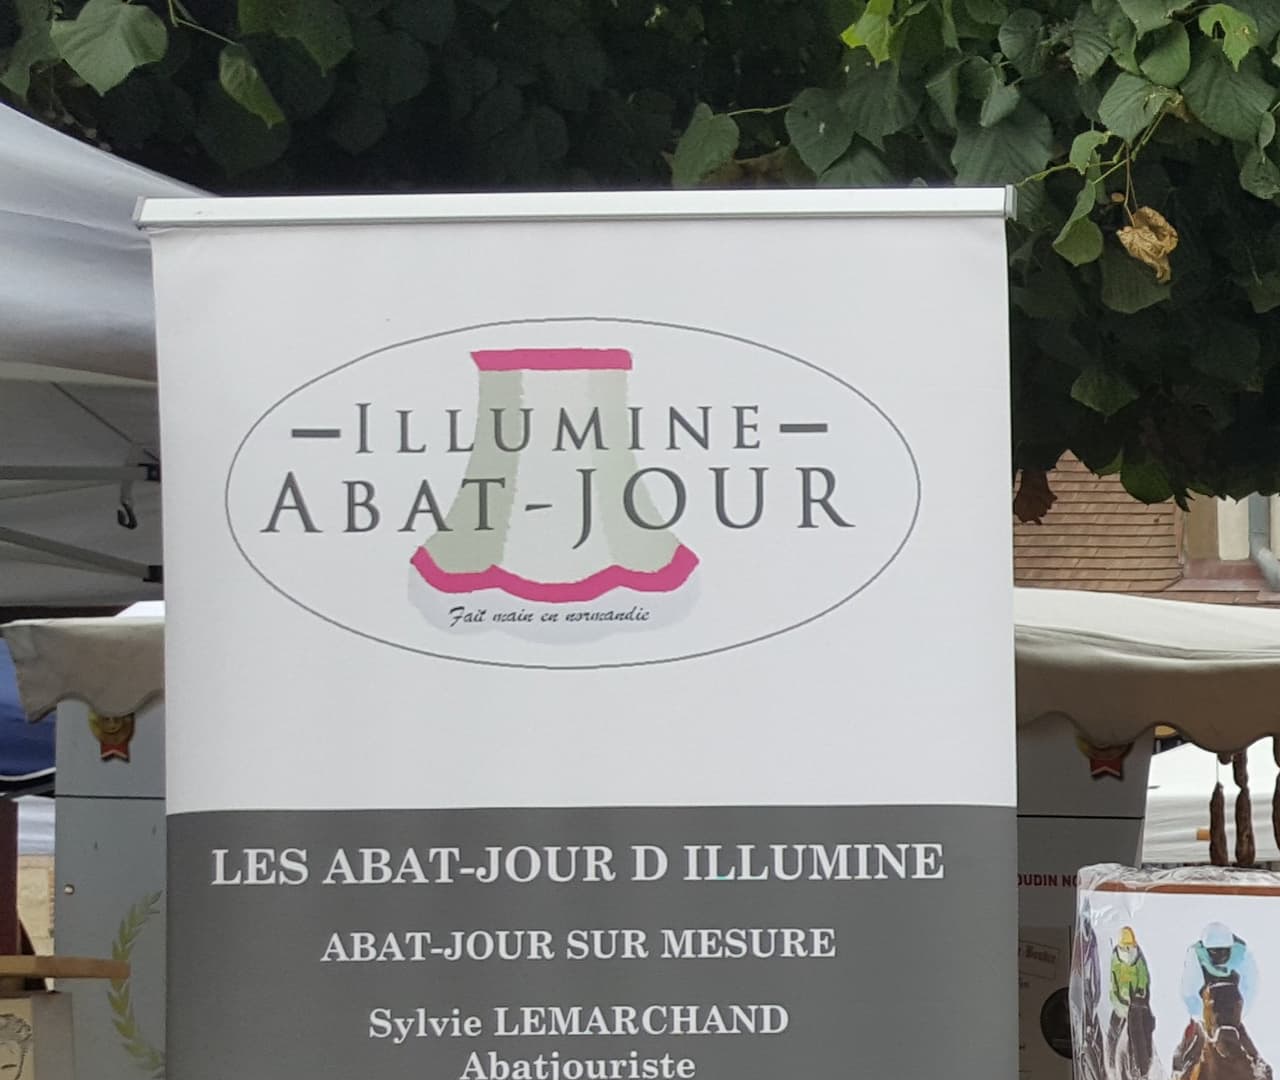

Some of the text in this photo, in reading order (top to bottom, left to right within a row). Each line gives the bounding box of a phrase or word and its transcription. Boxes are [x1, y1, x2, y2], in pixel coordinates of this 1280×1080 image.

[260, 465, 857, 550] ABAT-JOUR
[448, 606, 651, 628] Fait main en normandie
[212, 843, 944, 885] LES ABAT-JOUR D ILLUMINE
[320, 928, 836, 962] ABAT-JOUR SUR MESURE
[369, 1004, 789, 1044] Sylvie LEMARCHAND
